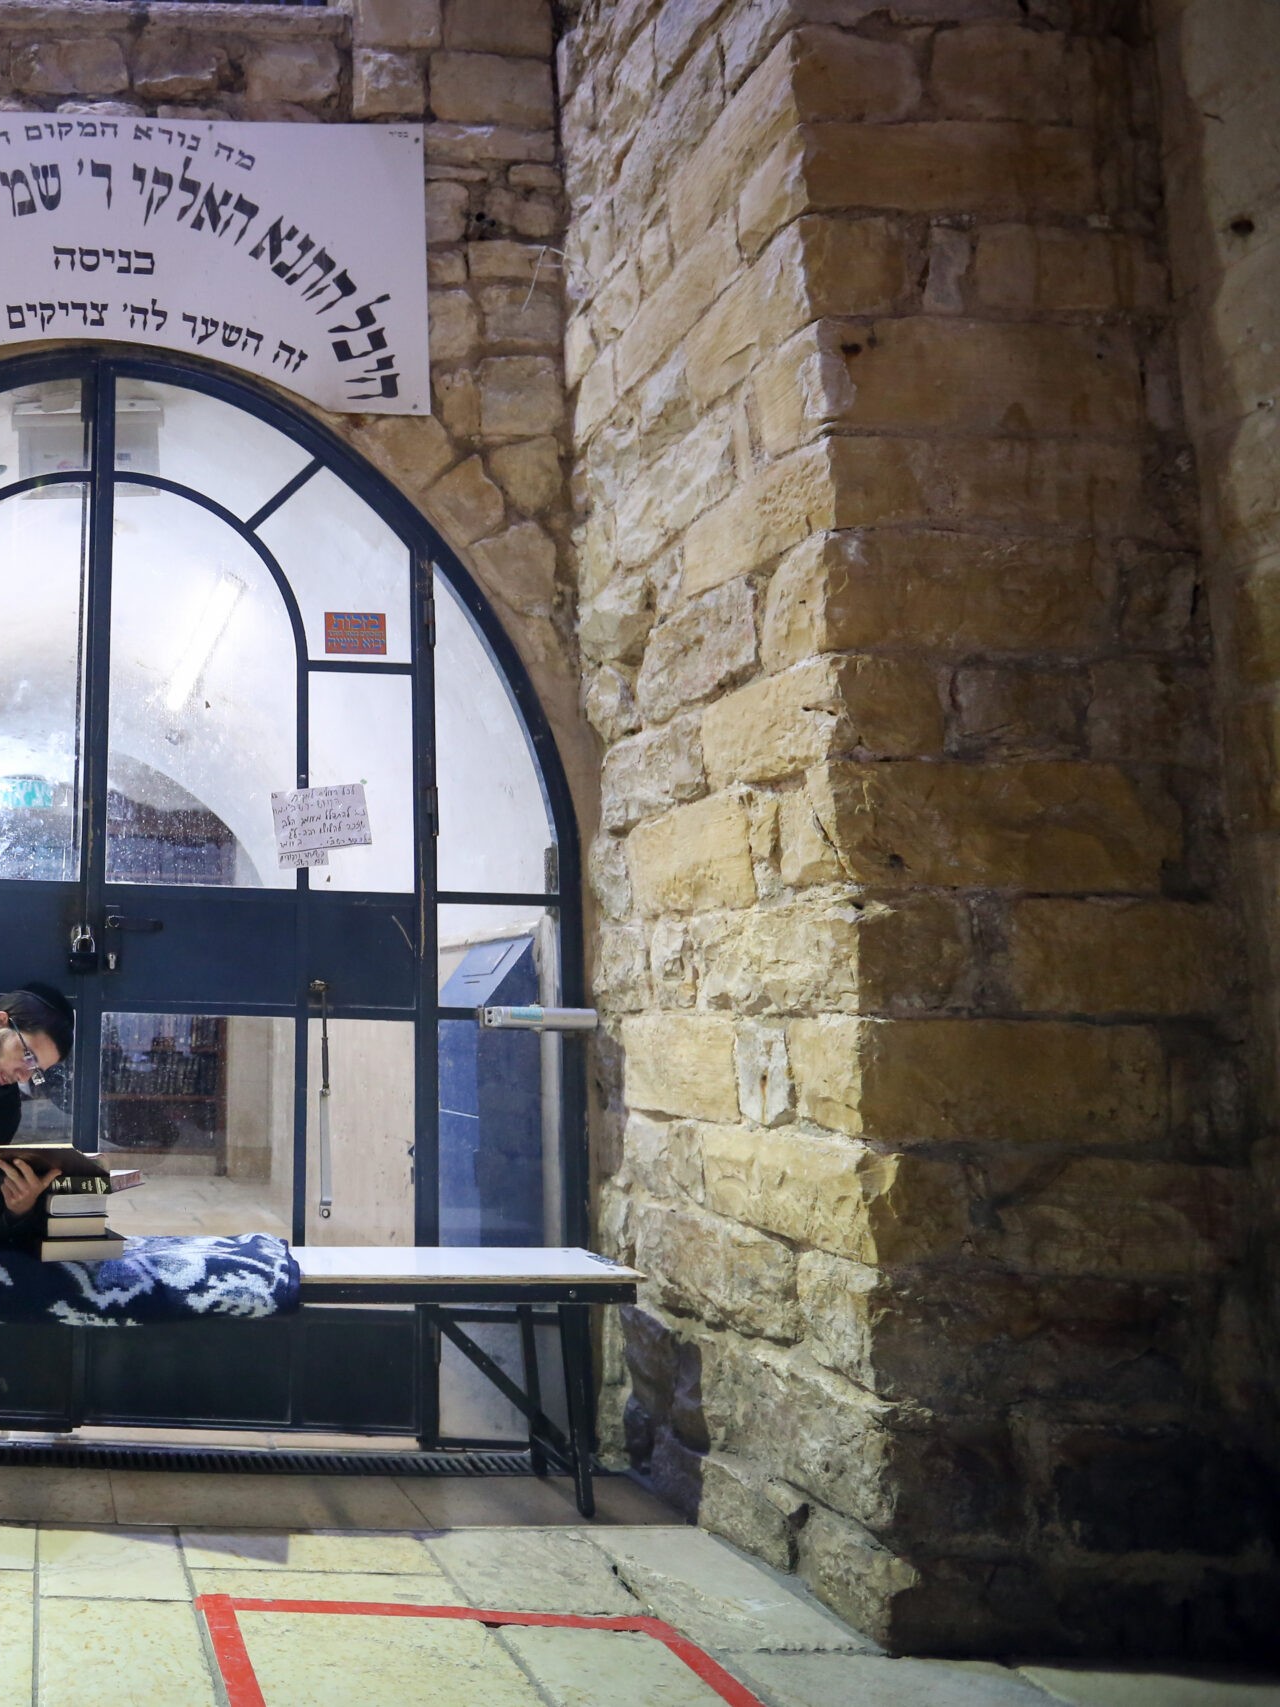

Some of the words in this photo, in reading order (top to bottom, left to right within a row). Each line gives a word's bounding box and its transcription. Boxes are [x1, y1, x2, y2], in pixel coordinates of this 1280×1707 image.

[24, 121, 118, 142] המקום
[133, 124, 201, 152] נורא
[215, 142, 256, 171] מה
[132, 156, 260, 244] האלקי
[52, 245, 156, 276] כניסה
[249, 216, 358, 315] התנא
[6, 300, 109, 333] צדיקים
[122, 298, 168, 332] לה'
[176, 312, 264, 356] השער
[327, 292, 401, 400] היכל
[272, 339, 309, 373] זה
[332, 613, 380, 630] בזכות
